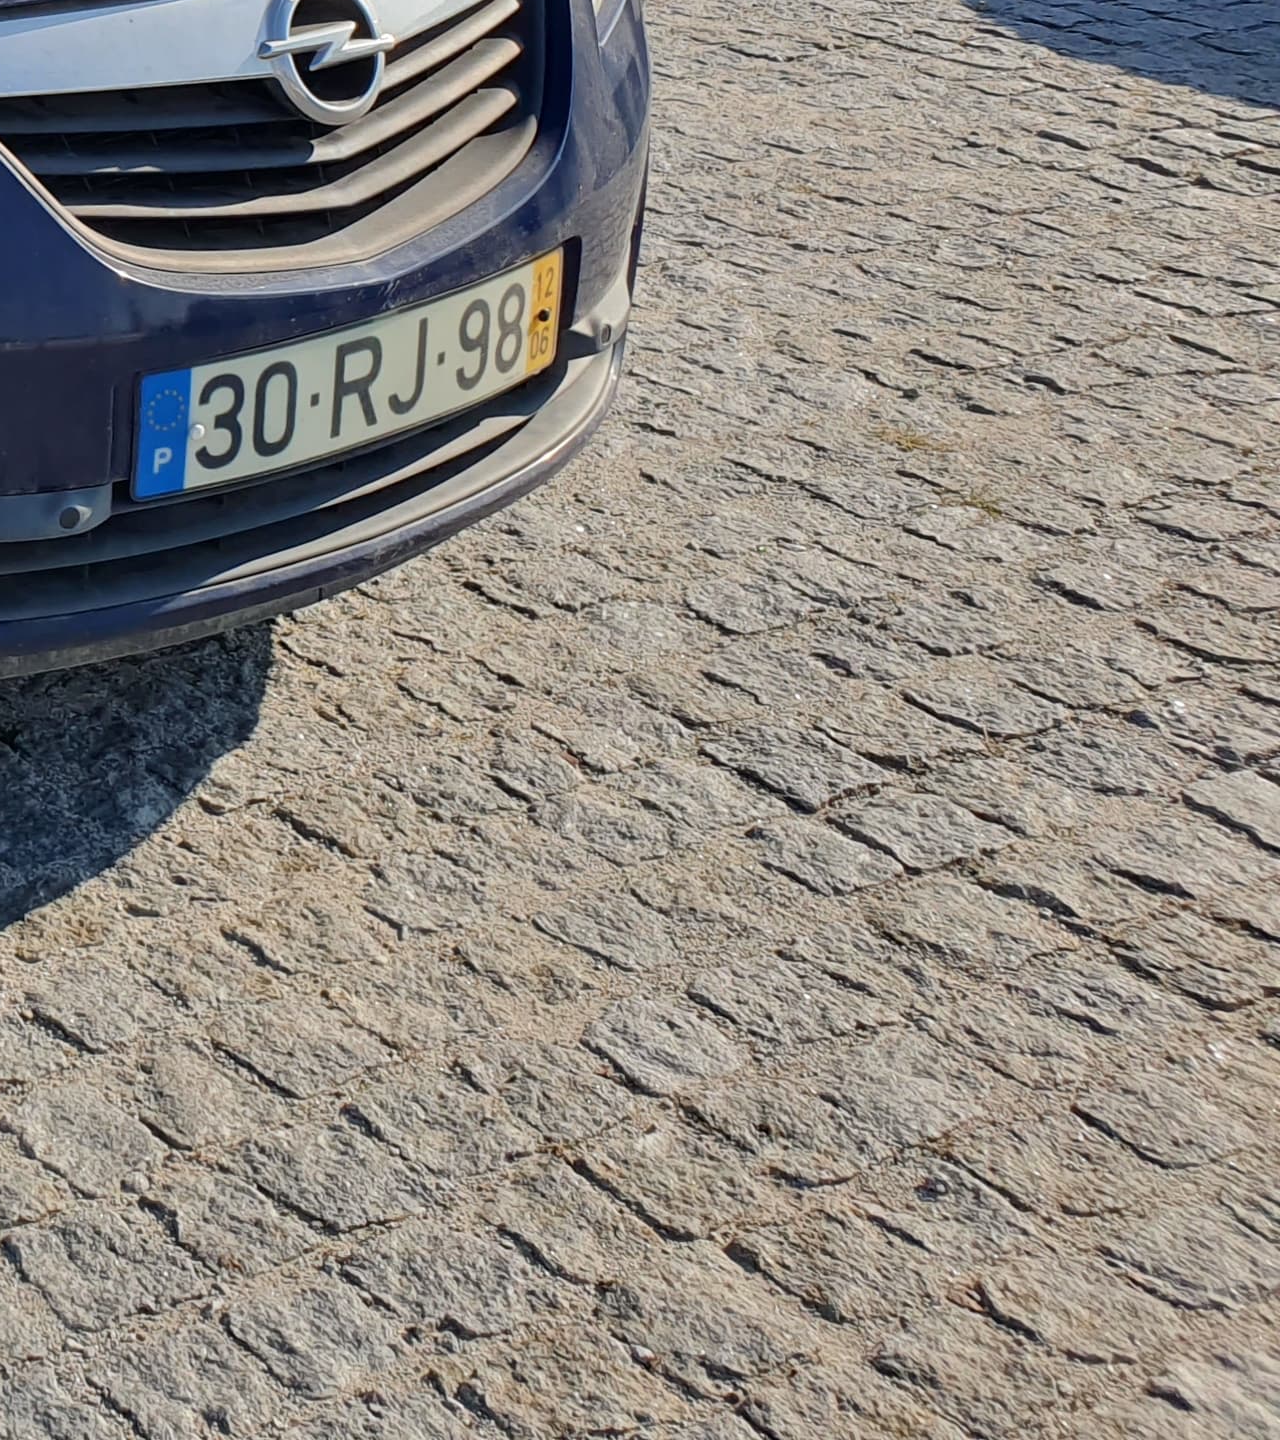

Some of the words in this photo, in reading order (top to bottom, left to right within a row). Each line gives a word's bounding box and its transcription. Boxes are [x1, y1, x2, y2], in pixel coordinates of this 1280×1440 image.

[537, 266, 554, 302] 12
[530, 325, 550, 360] 06
[153, 447, 173, 475] P
